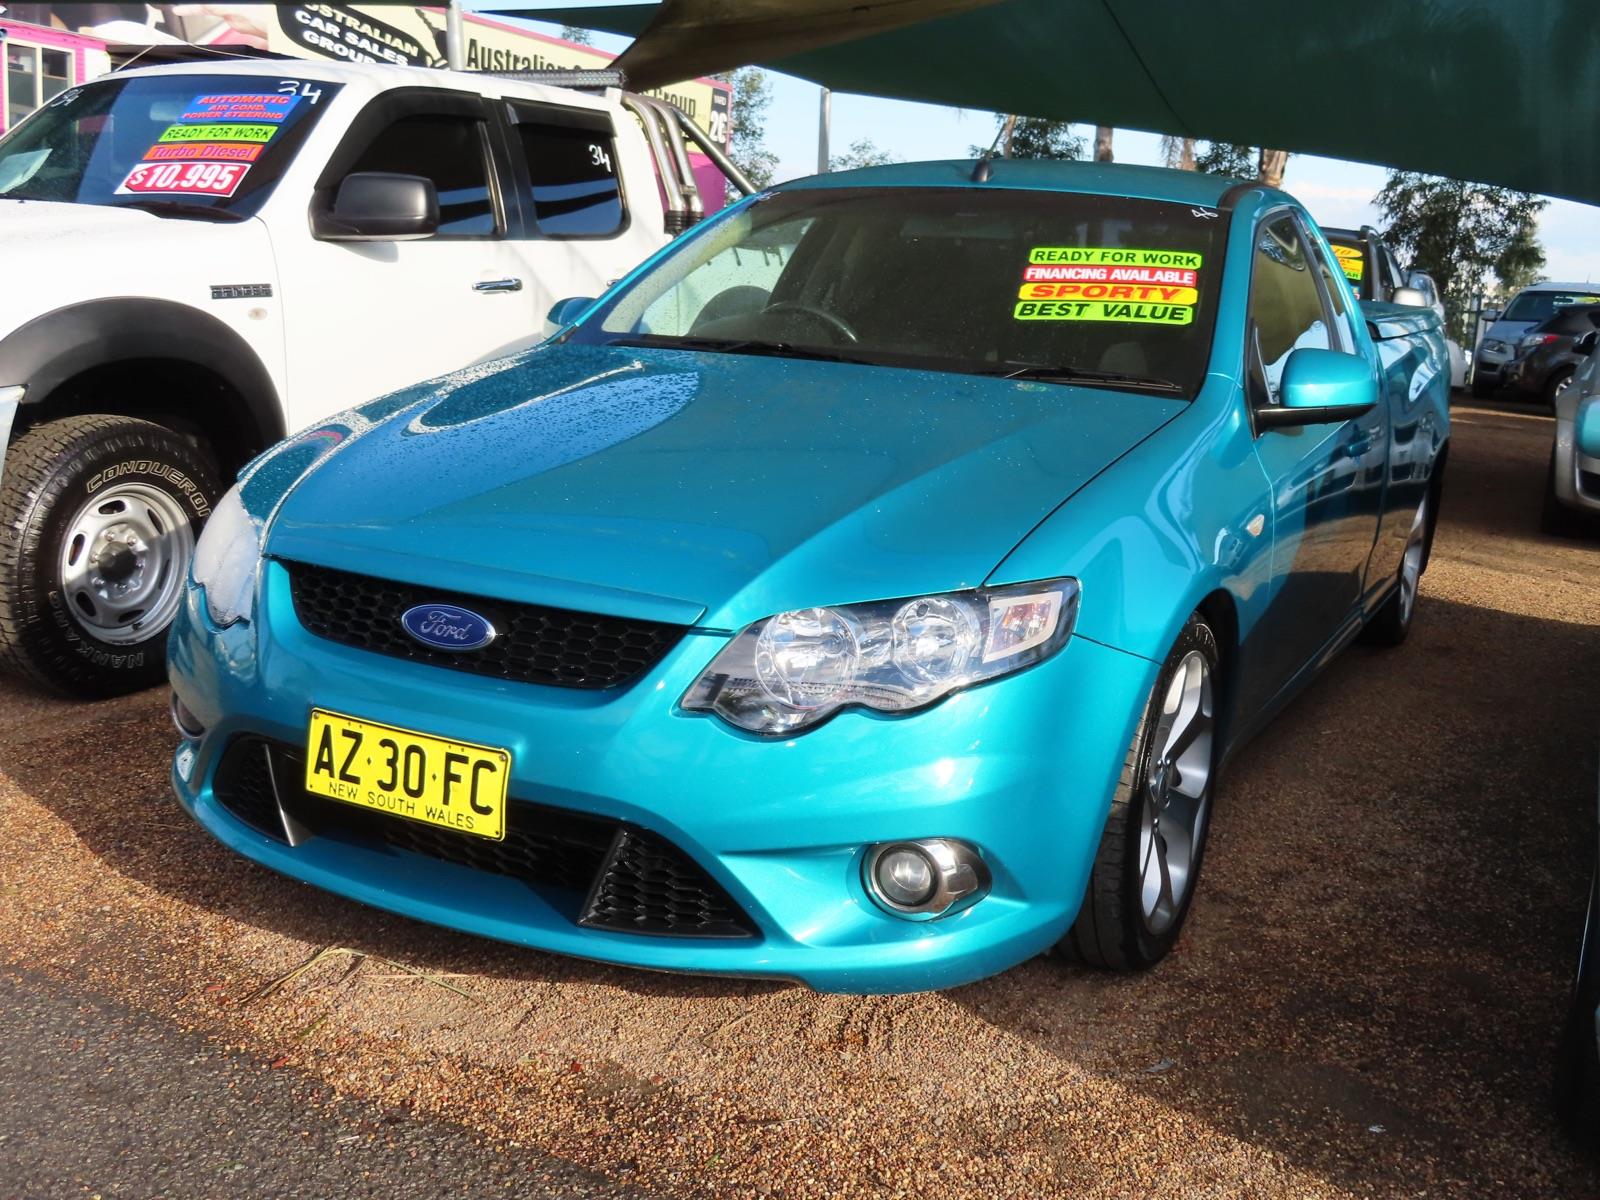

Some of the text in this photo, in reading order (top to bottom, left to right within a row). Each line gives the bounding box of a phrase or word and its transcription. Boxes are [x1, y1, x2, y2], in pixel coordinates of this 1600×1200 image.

[295, 10, 409, 66] CAR SALES
[304, 4, 419, 58] USTRALIAN
[197, 95, 291, 105] AUTOMATIC
[278, 81, 322, 105] 34
[182, 111, 285, 119] POWER STEERING
[166, 127, 273, 140] READY FOR WORK
[152, 145, 256, 158] Turbo Diesel
[588, 144, 612, 173] 34
[130, 164, 241, 191] $10,995
[1034, 250, 1199, 267] READY FOR WORK
[1026, 267, 1194, 285] FINANCING AVAILABLE
[1029, 284, 1183, 301] SPORTY
[1018, 302, 1188, 321] BEST VALUE
[420, 610, 473, 641] Ford
[328, 781, 475, 830] NEW SOUTH WALES
